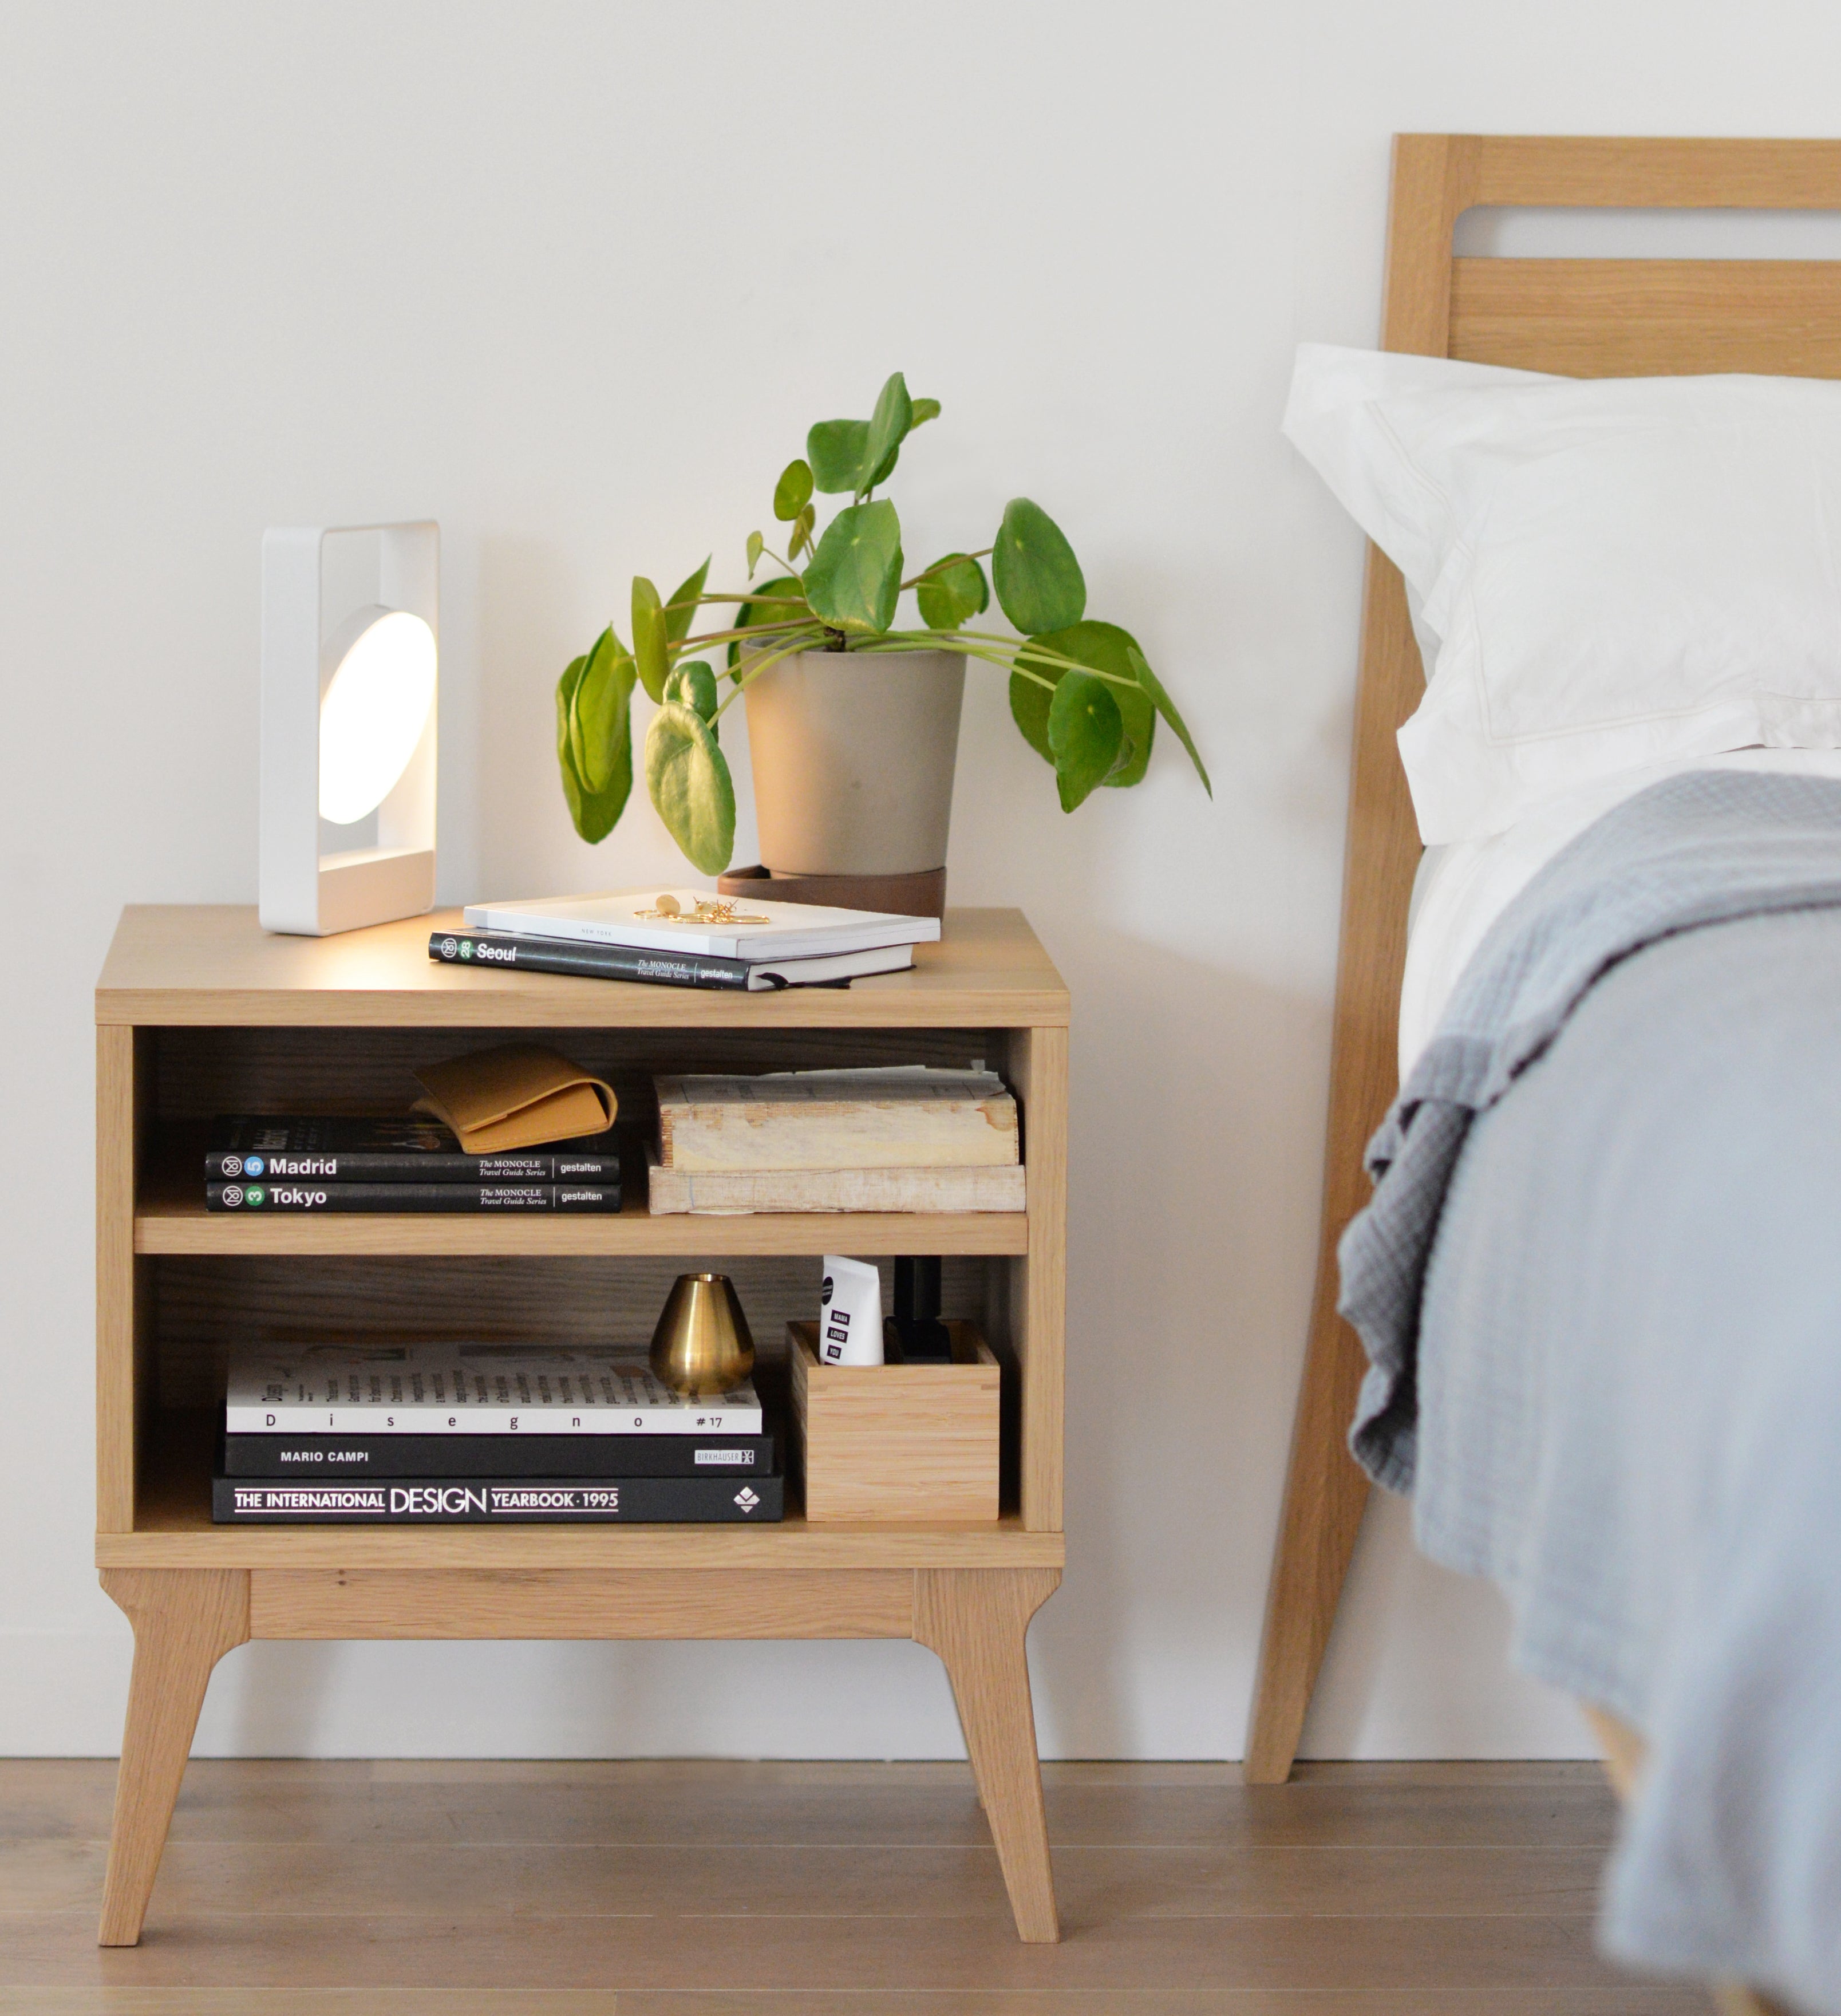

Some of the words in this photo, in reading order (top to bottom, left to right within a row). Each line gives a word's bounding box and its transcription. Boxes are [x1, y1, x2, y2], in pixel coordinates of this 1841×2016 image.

[461, 942, 471, 957] 28
[477, 944, 516, 961] Seoul
[655, 969, 672, 978] Guide
[701, 969, 733, 979] gestalten
[247, 1162, 261, 1171] 5
[270, 1159, 337, 1174] Madrid
[560, 1163, 601, 1173] gestalten
[248, 1191, 262, 1201] 3
[270, 1188, 327, 1206] Tokyo
[562, 1192, 602, 1202] gestalten
[830, 1329, 845, 1340] LOVES
[829, 1348, 839, 1356] YOU
[281, 1451, 323, 1461] MARIO
[328, 1451, 368, 1461] CAMPI
[235, 1493, 262, 1507] THE
[267, 1493, 385, 1507] INTERNATIONAL
[390, 1488, 487, 1513] DESIGN
[492, 1493, 574, 1507] YEARBOOK
[583, 1493, 618, 1507] 1995
